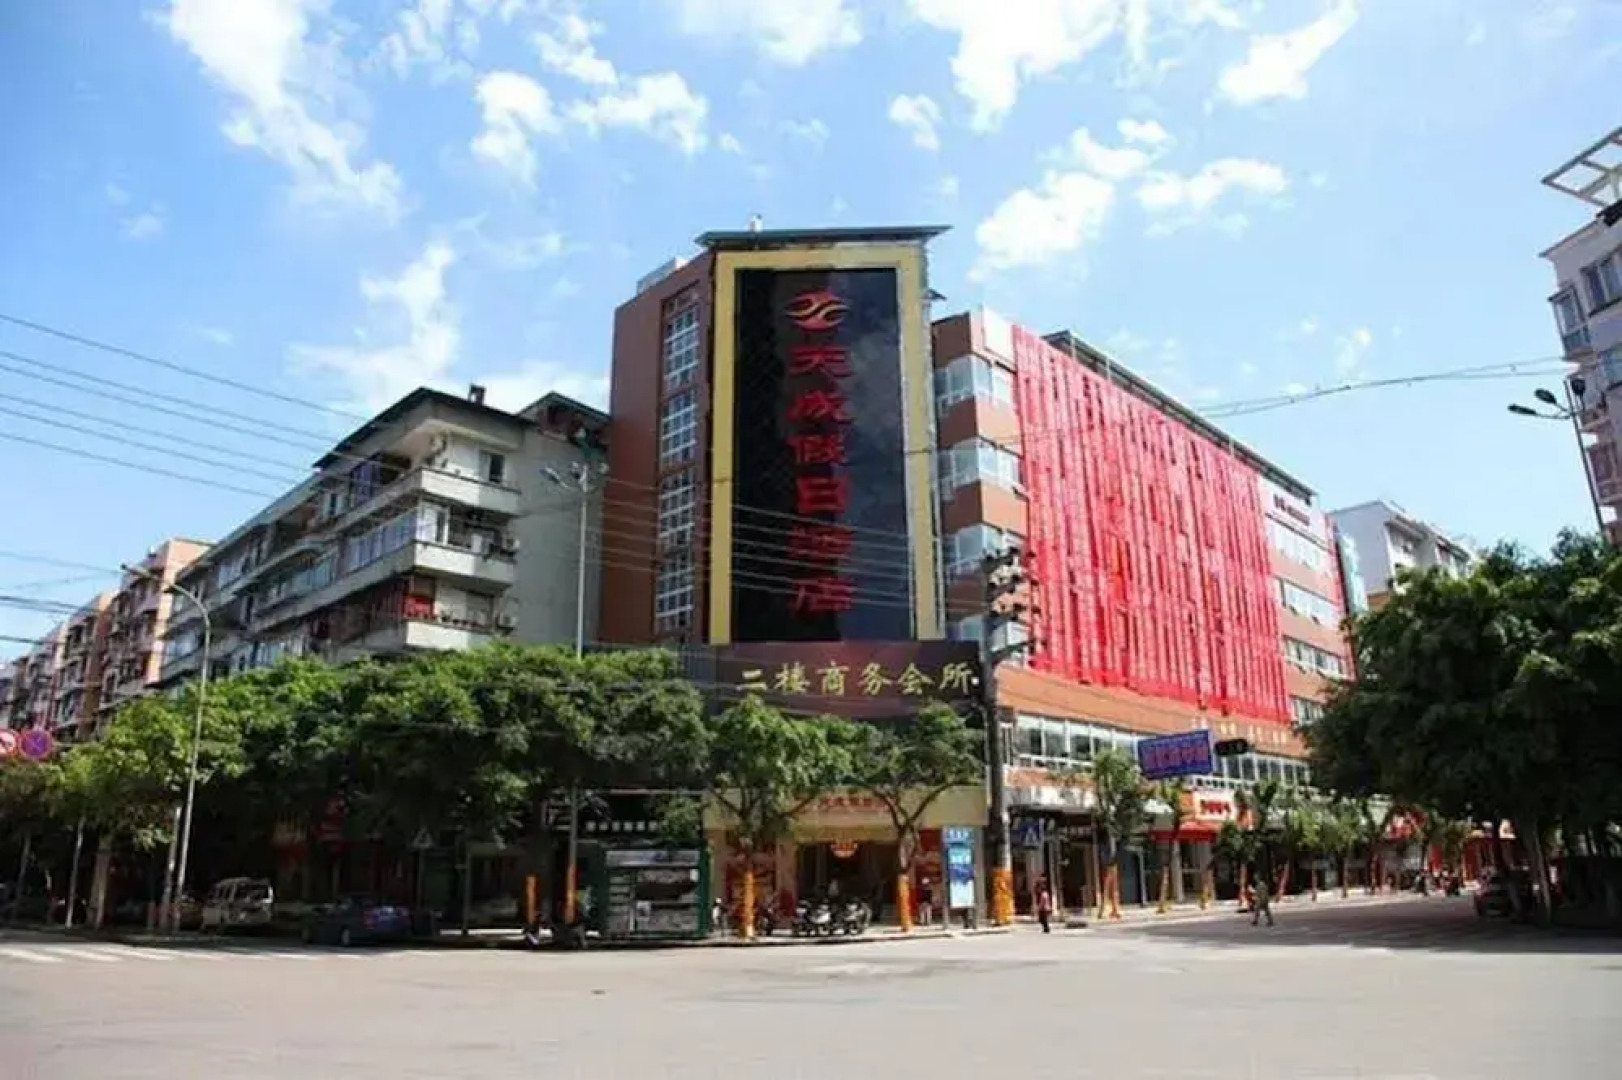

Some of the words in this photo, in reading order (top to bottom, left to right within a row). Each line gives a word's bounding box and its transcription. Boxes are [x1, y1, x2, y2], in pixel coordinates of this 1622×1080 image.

[740, 661, 973, 696] 二楼商务会所
